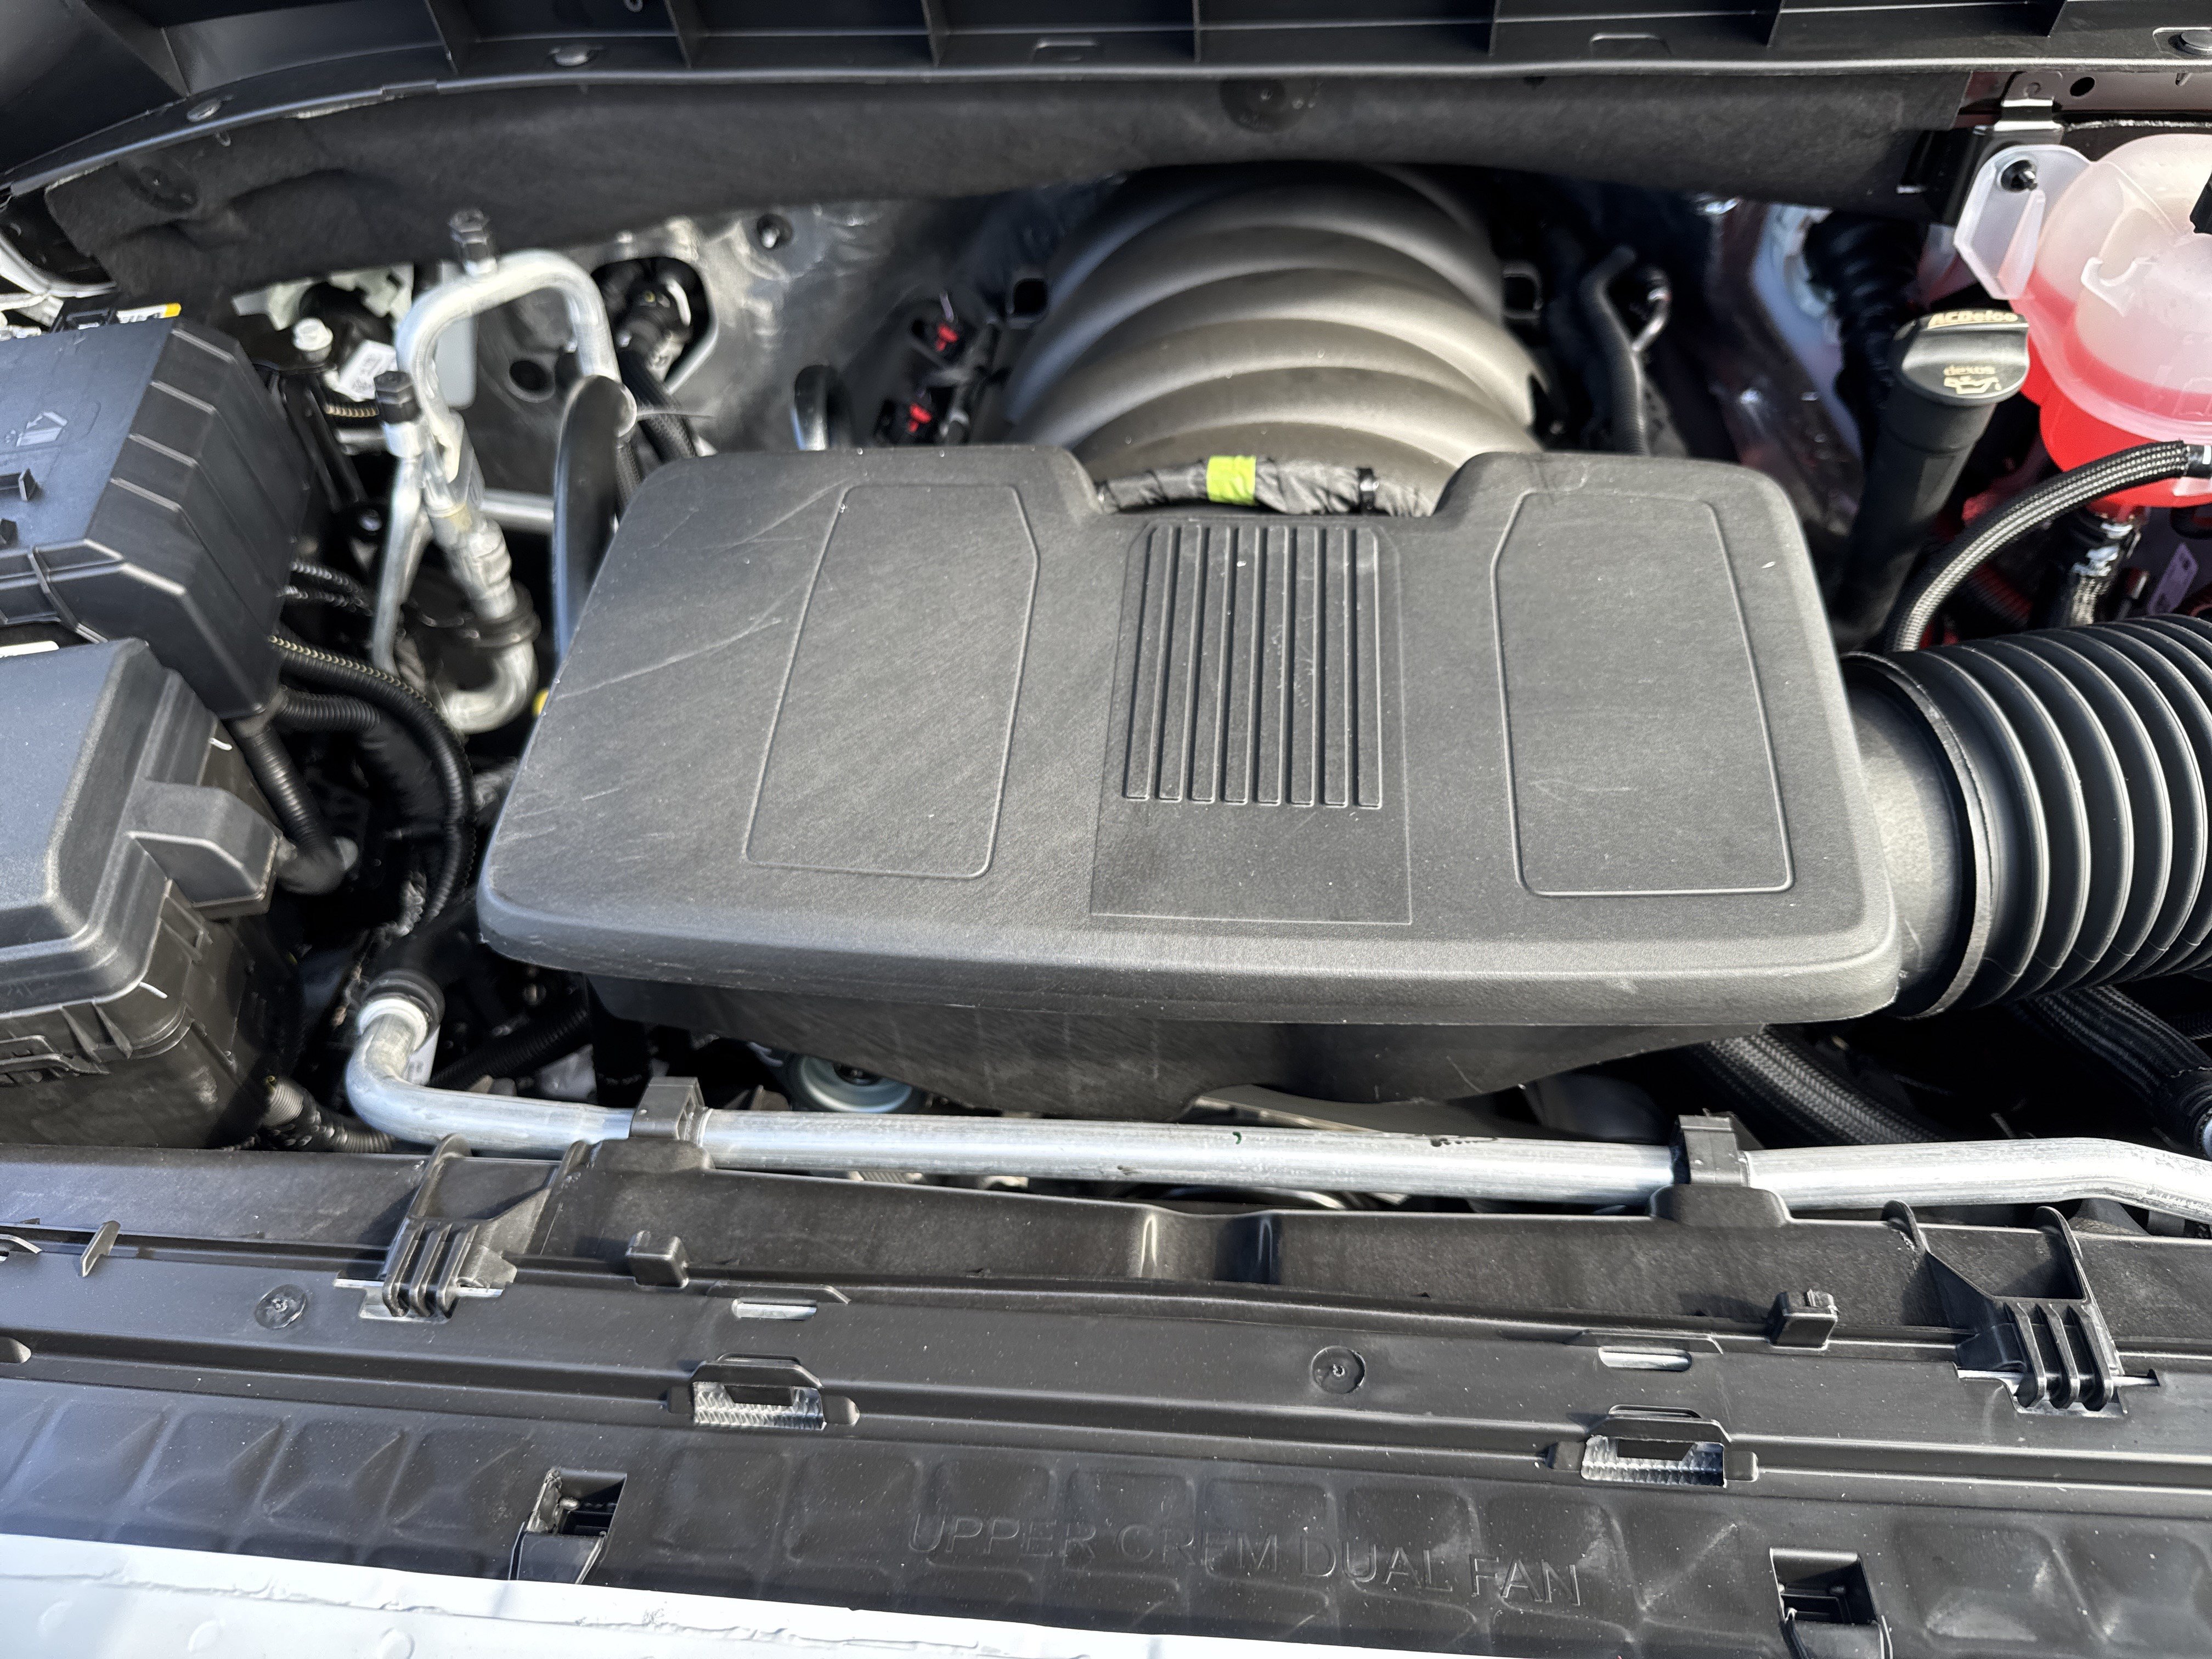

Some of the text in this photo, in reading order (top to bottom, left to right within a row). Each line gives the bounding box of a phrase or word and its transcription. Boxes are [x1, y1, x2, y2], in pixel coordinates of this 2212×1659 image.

[1928, 310, 2018, 328] ACDelco
[909, 1513, 1097, 1561] UPPER
[1301, 1536, 1453, 1593] DUAL
[1470, 1554, 1581, 1607] FAN
